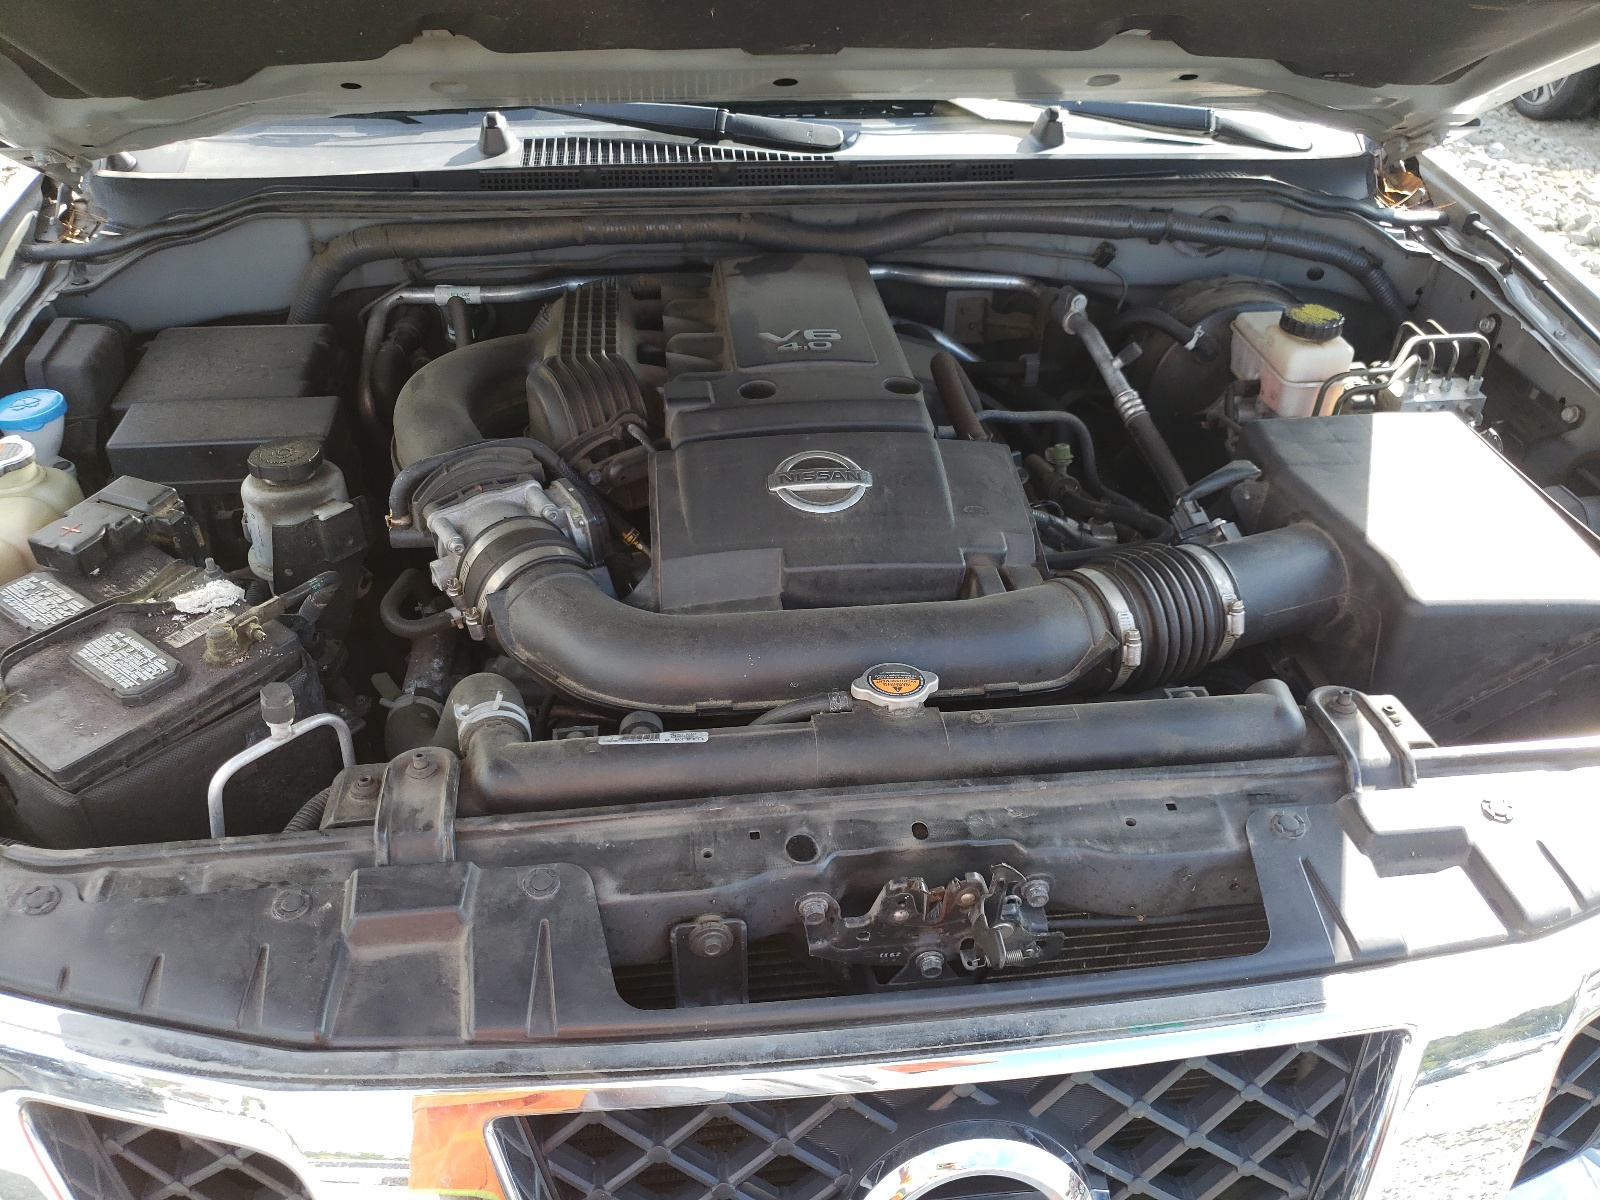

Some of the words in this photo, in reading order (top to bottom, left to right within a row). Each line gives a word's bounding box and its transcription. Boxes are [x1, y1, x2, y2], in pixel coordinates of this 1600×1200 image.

[757, 329, 842, 343] V6
[777, 341, 832, 351] 4.0
[779, 471, 862, 483] NISSAN
